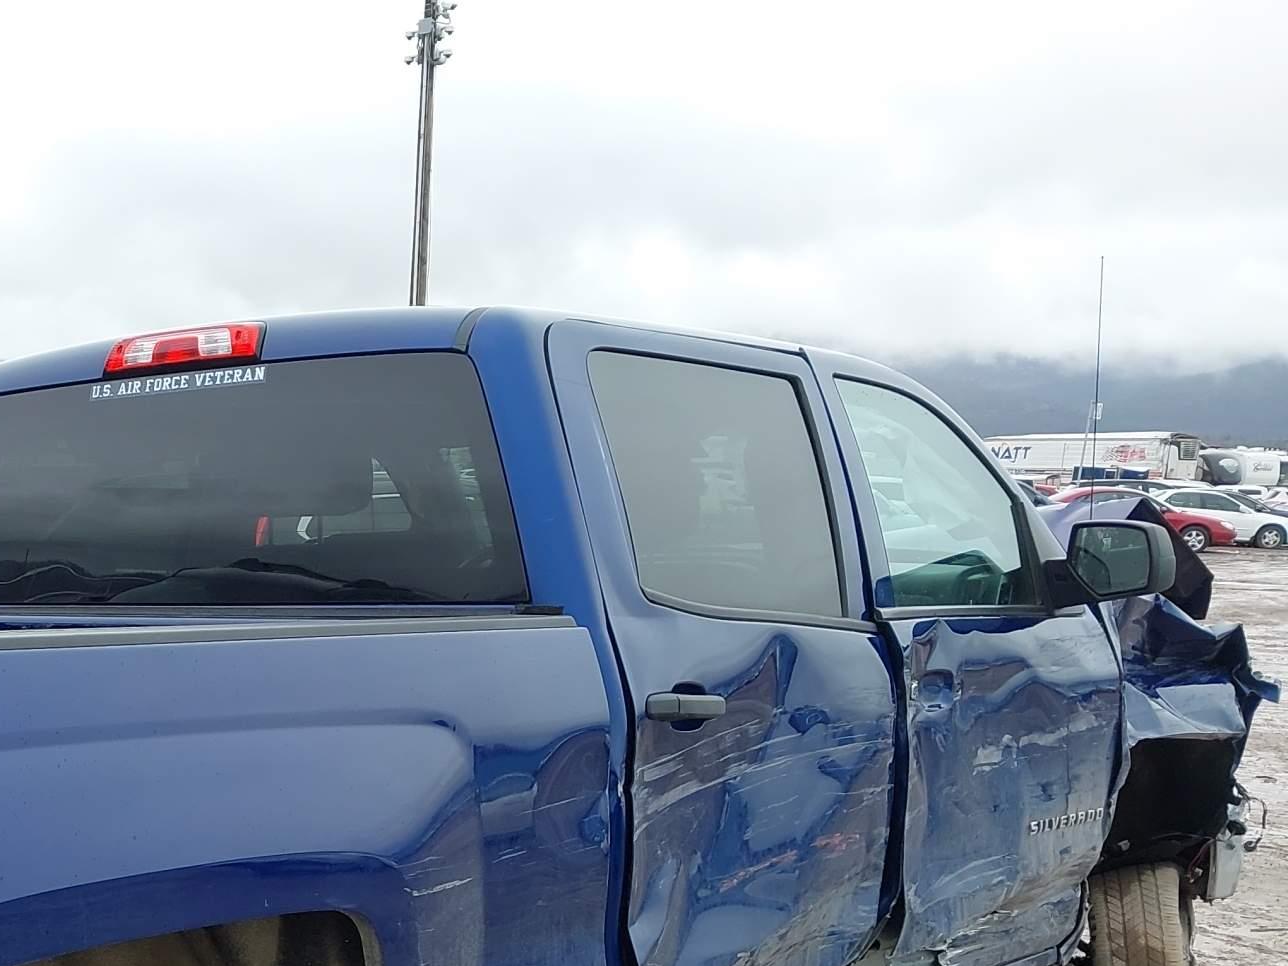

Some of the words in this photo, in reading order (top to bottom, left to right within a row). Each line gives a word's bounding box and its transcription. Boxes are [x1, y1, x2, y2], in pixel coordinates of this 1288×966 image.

[92, 384, 113, 398] U.S.
[117, 380, 141, 395] AIR
[145, 375, 189, 392] FORCE
[195, 366, 265, 387] VETERAN
[1029, 807, 1104, 836] SILVERADO
